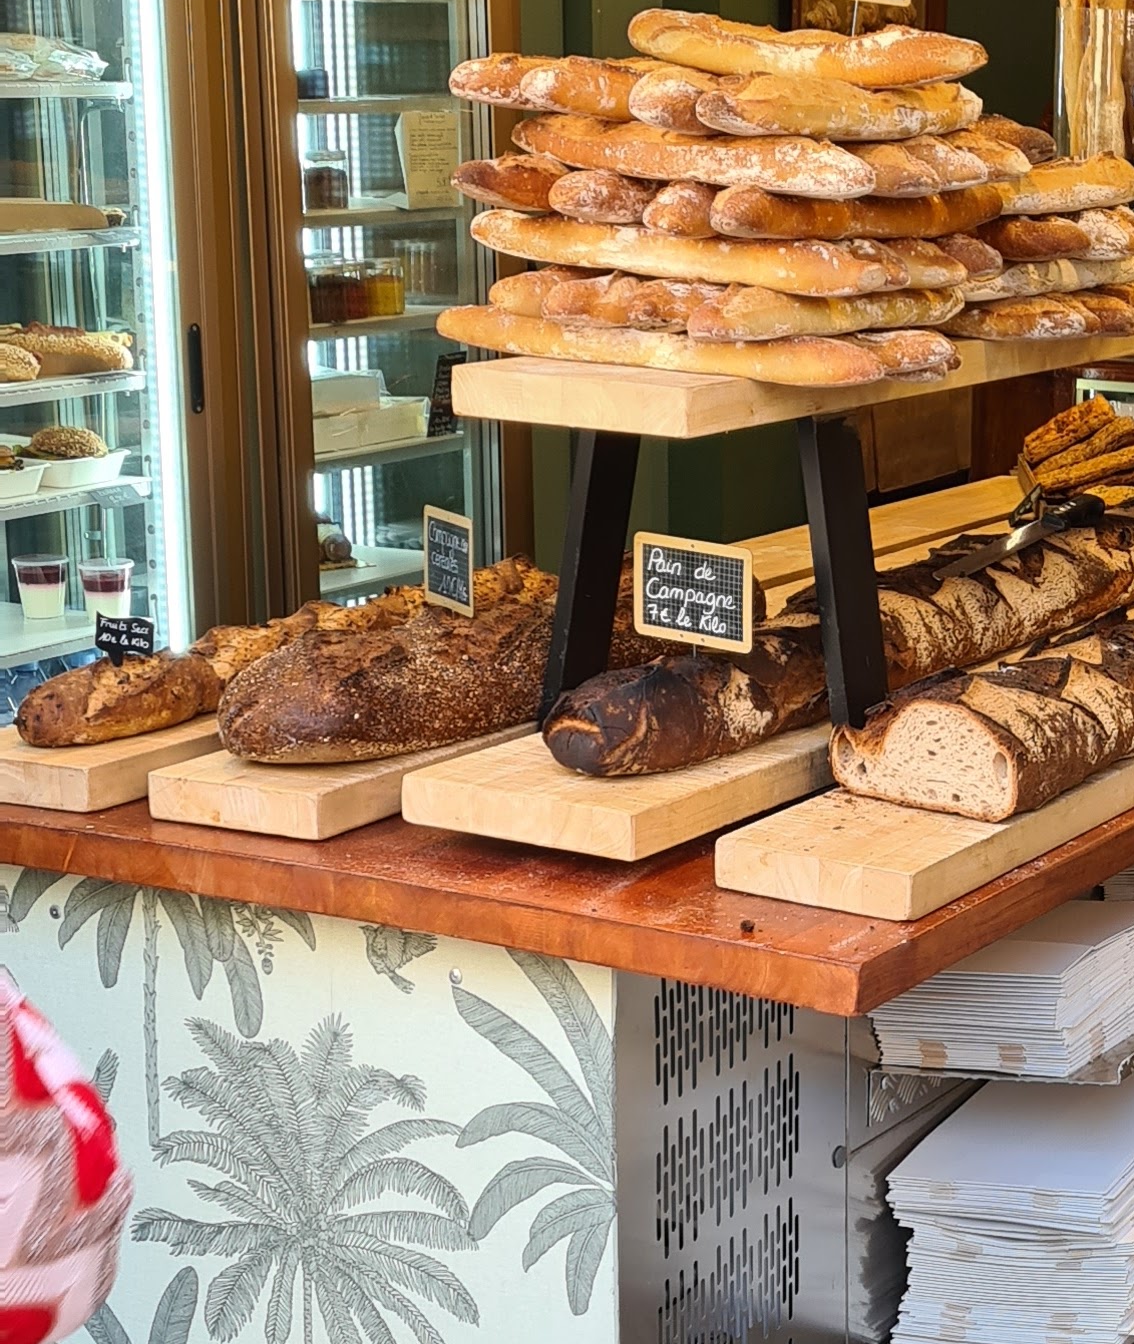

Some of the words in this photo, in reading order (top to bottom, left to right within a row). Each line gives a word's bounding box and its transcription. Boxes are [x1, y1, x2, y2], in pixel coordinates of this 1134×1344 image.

[647, 547, 682, 576] Pain
[694, 561, 717, 581] de
[645, 577, 737, 615] Campagne
[99, 617, 128, 632] Fruits
[675, 607, 693, 628] le
[699, 615, 727, 634] Kilo
